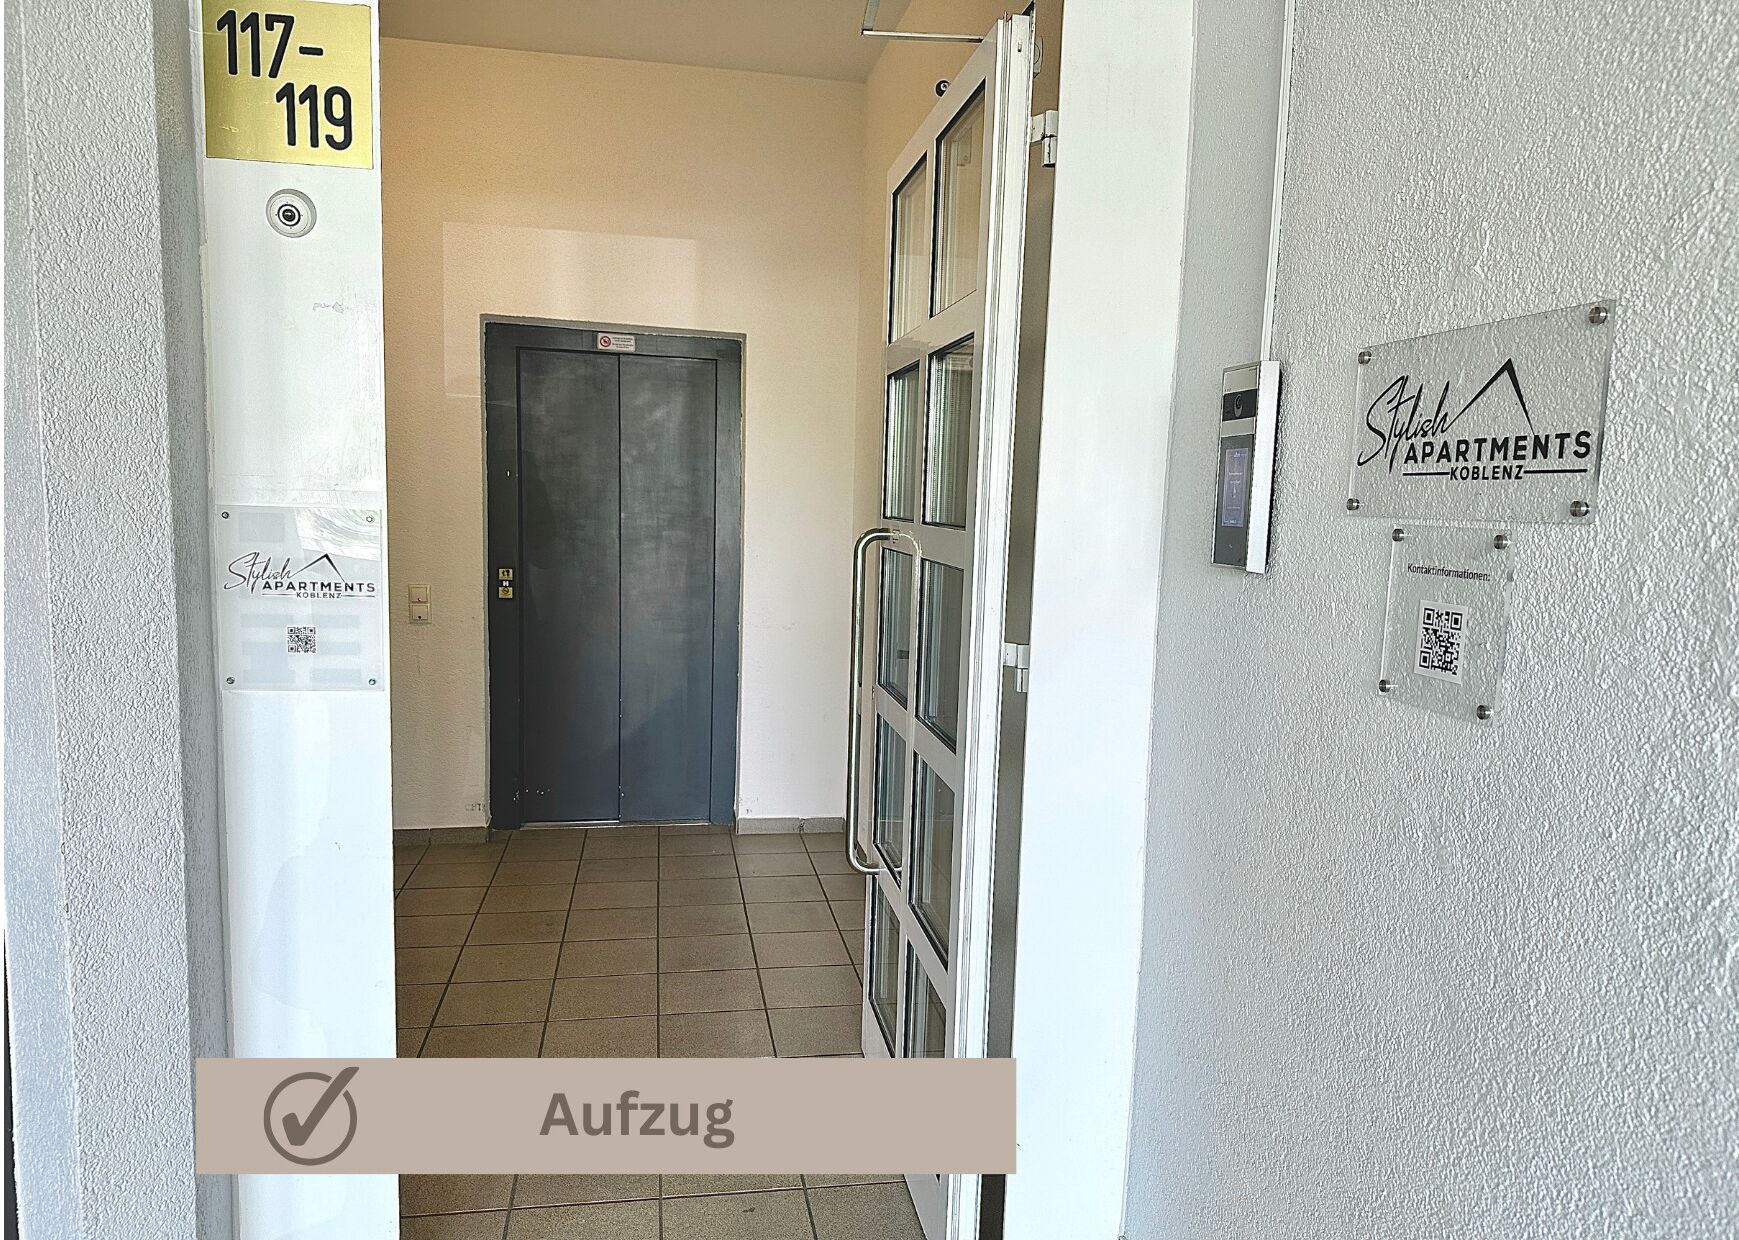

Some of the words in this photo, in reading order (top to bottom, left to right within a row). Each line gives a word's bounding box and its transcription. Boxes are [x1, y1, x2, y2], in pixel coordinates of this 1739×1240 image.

[217, 9, 324, 79] 117-
[275, 82, 353, 151] 119
[1357, 375, 1450, 474] Stylish
[1404, 430, 1592, 464] APARTMENTS
[1449, 465, 1524, 481] KOBLENZ
[223, 551, 292, 594] Stylish
[262, 581, 376, 592] APARTMENTS
[1407, 563, 1491, 582] Kontaktinformationen:
